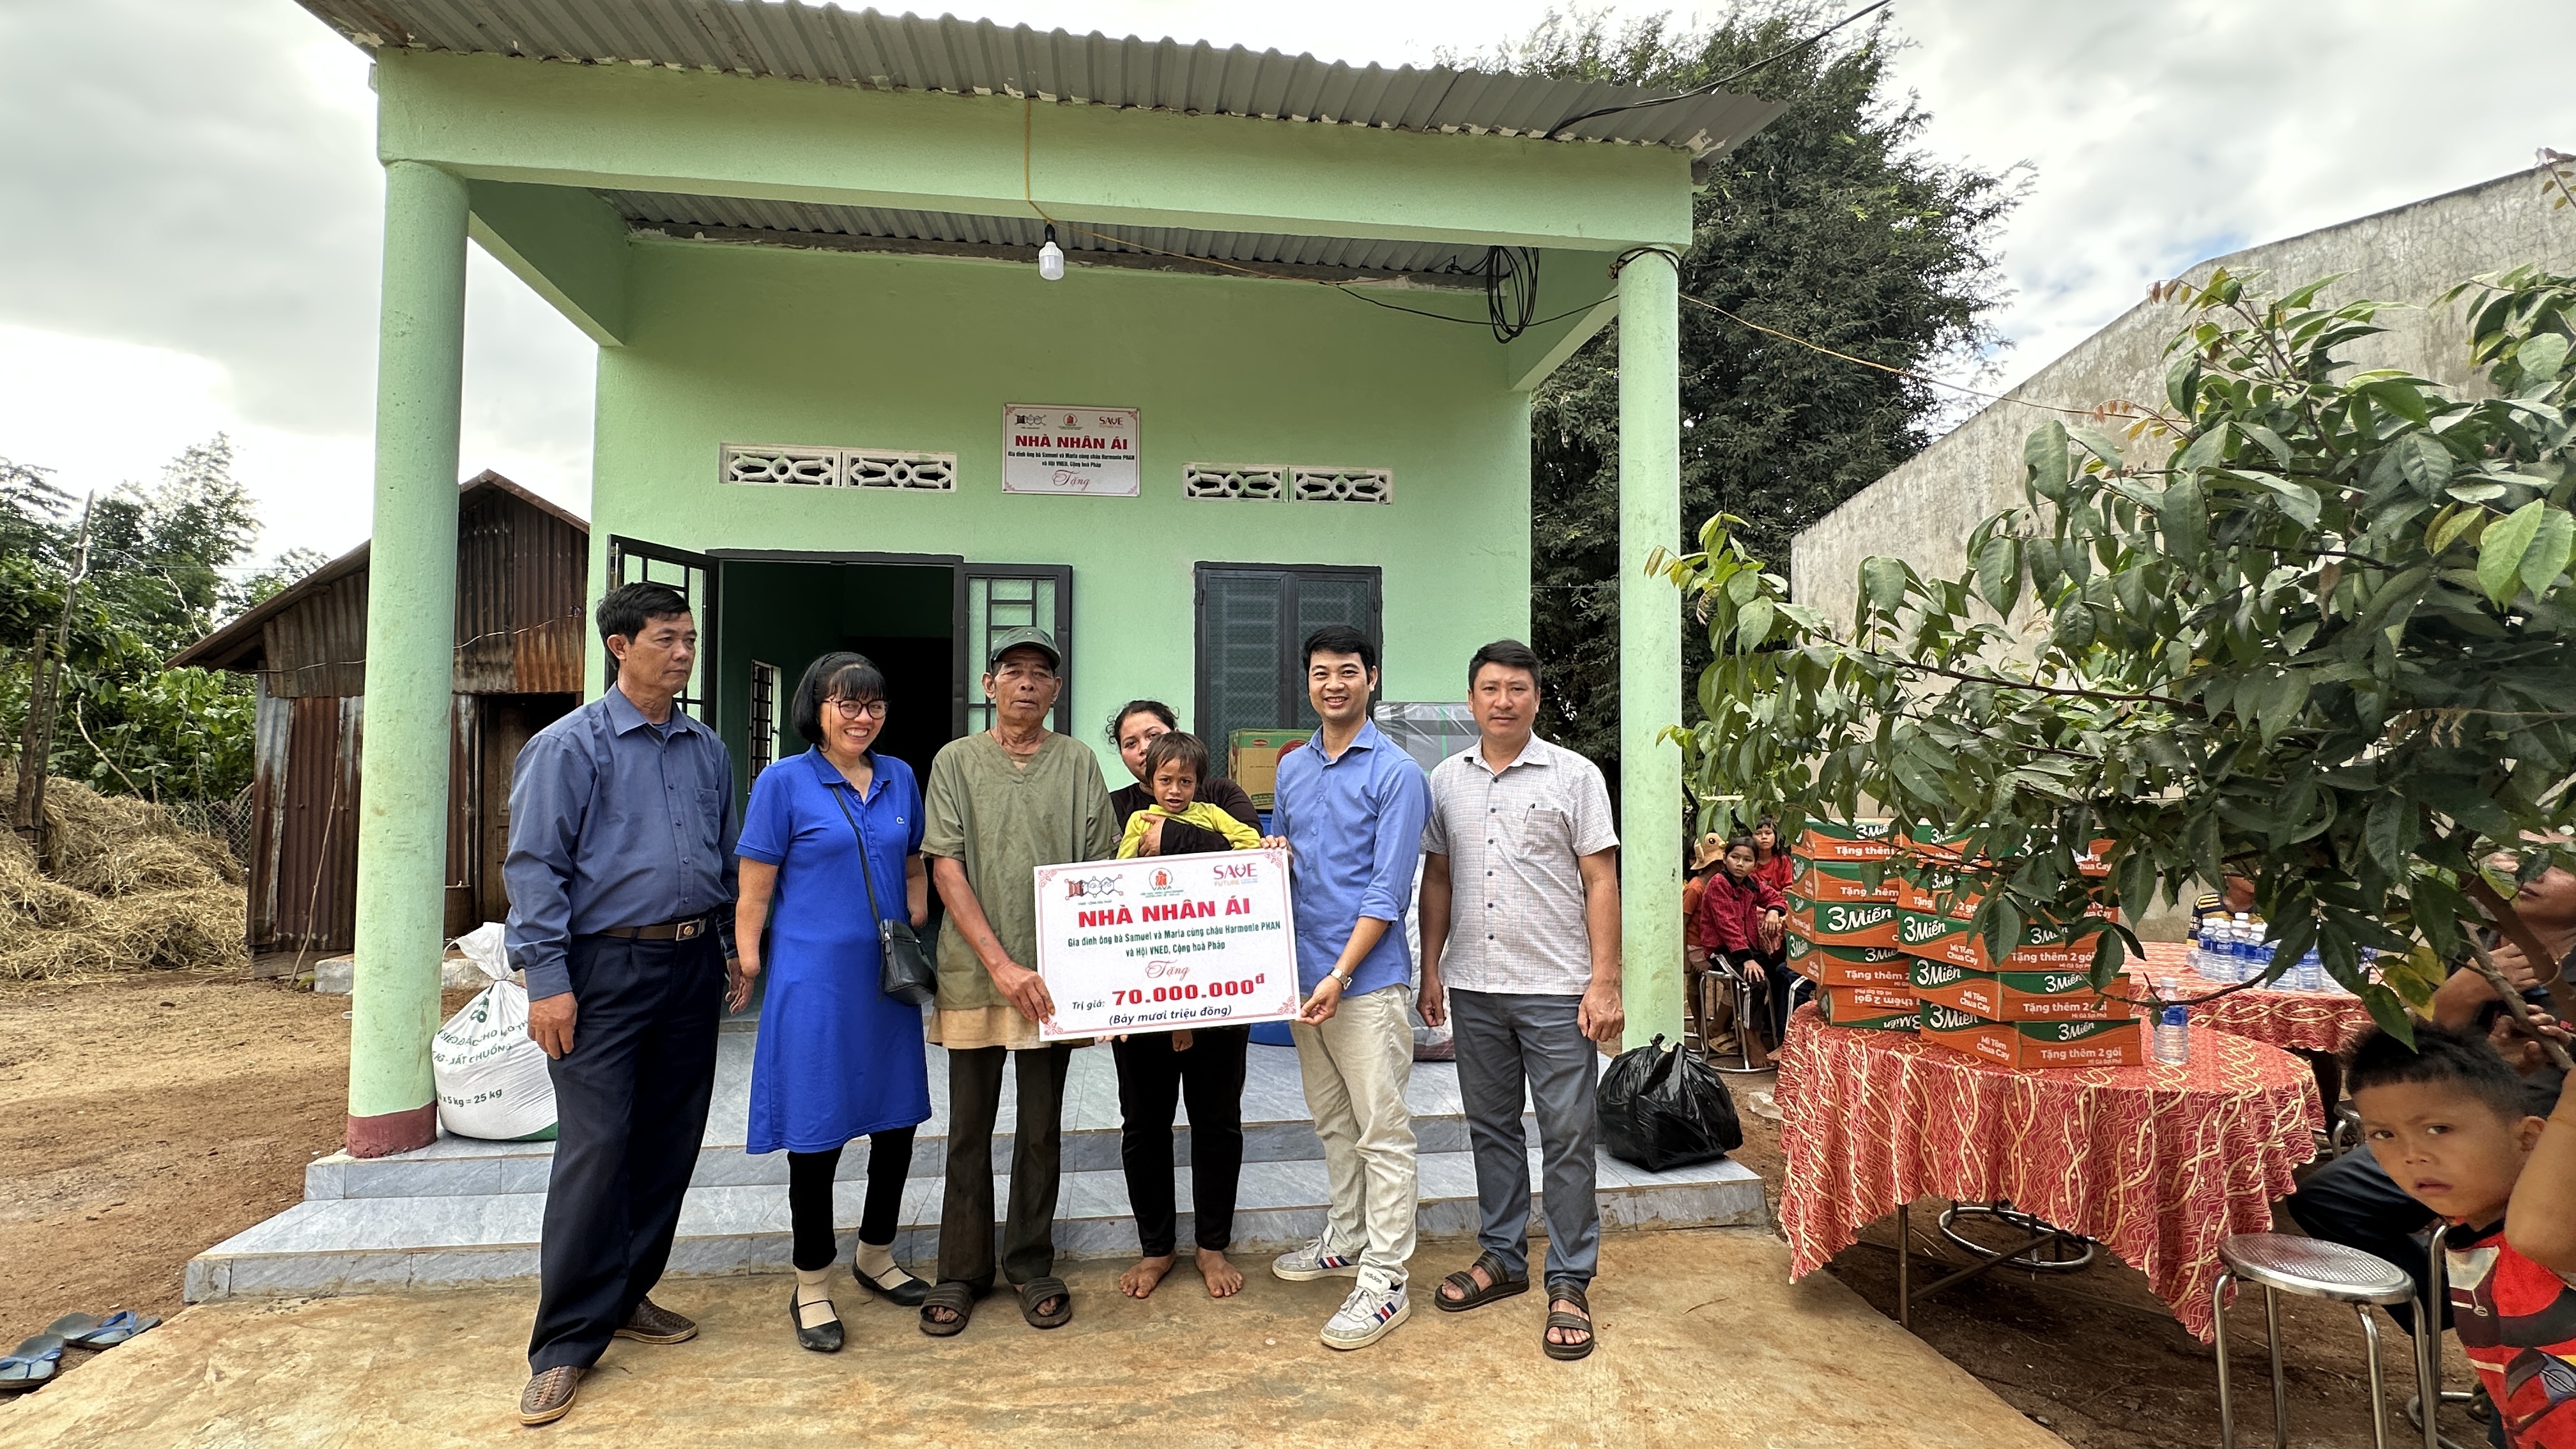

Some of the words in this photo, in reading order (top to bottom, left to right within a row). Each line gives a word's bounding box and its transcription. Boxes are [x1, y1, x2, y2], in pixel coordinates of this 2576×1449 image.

[1015, 434, 1051, 447] NHÀ
[1057, 435, 1105, 449] NHÂN
[1110, 436, 1128, 450] ÁI
[1053, 470, 1091, 491] Tặng
[1834, 845, 1863, 857] Tặng
[1213, 862, 1258, 880] SAVE
[2096, 863, 2113, 873] Cay
[1839, 886, 1867, 898] Tặng
[1872, 887, 1899, 897] hêm
[1913, 896, 1933, 908] Tặng
[1078, 904, 1133, 928] NHÀ
[1142, 899, 1216, 923] NHÂN
[1225, 895, 1251, 916] ÁI
[1068, 937, 1080, 947] Gia
[1082, 935, 1098, 946] đình
[1099, 935, 1113, 945] ông
[1114, 933, 1123, 944] bà
[1125, 931, 1152, 942] Samuel
[1154, 930, 1162, 940] và
[1164, 929, 1185, 939] Maria
[1186, 926, 1204, 938] cùng
[1206, 924, 1223, 935] cháu
[1225, 923, 1260, 935] Harmonie
[1261, 921, 1281, 931] PHAN
[1125, 947, 1135, 958] và
[1136, 946, 1148, 958] Hội
[1150, 944, 1172, 955] VNED,
[1172, 942, 1191, 955] Cộng
[1208, 940, 1226, 951] Pháp
[1947, 951, 1965, 961] Chua
[1965, 956, 1979, 966] Cay
[2011, 952, 2037, 963] Tặng
[2039, 952, 2068, 962] thêm
[2070, 953, 2076, 961] 2
[1145, 959, 1191, 981] Tặng
[1844, 970, 1872, 981] Tặng
[1874, 970, 1903, 980] thêm
[1972, 992, 1988, 1003] Tôm
[1072, 1000, 1084, 1010] Trị
[1085, 1000, 1106, 1011] giá:
[1959, 997, 1977, 1009] Chua
[1977, 1002, 1991, 1014] Cay
[2023, 1002, 2050, 1015] Tặng
[2051, 1001, 2081, 1012] thêm
[2082, 1002, 2089, 1011] 2
[1108, 1012, 1135, 1026] (Bảy
[1137, 1009, 1168, 1022] mươi
[1170, 1007, 1197, 1019] triệu
[1199, 1004, 1232, 1018] đồng)
[1977, 1043, 1995, 1054] Chua
[1996, 1049, 2010, 1061] Cay
[1991, 1039, 2007, 1050] Tôm
[2040, 1048, 2067, 1061] Tặng
[2069, 1048, 2096, 1057] thêm
[2098, 1048, 2105, 1057] 2
[2105, 1046, 2122, 1058] gói
[447, 1096, 452, 1104] 5
[454, 1097, 464, 1107] kg
[473, 1093, 487, 1104] 25
[489, 1089, 502, 1099] kg
[1364, 1271, 1383, 1284] adidas
